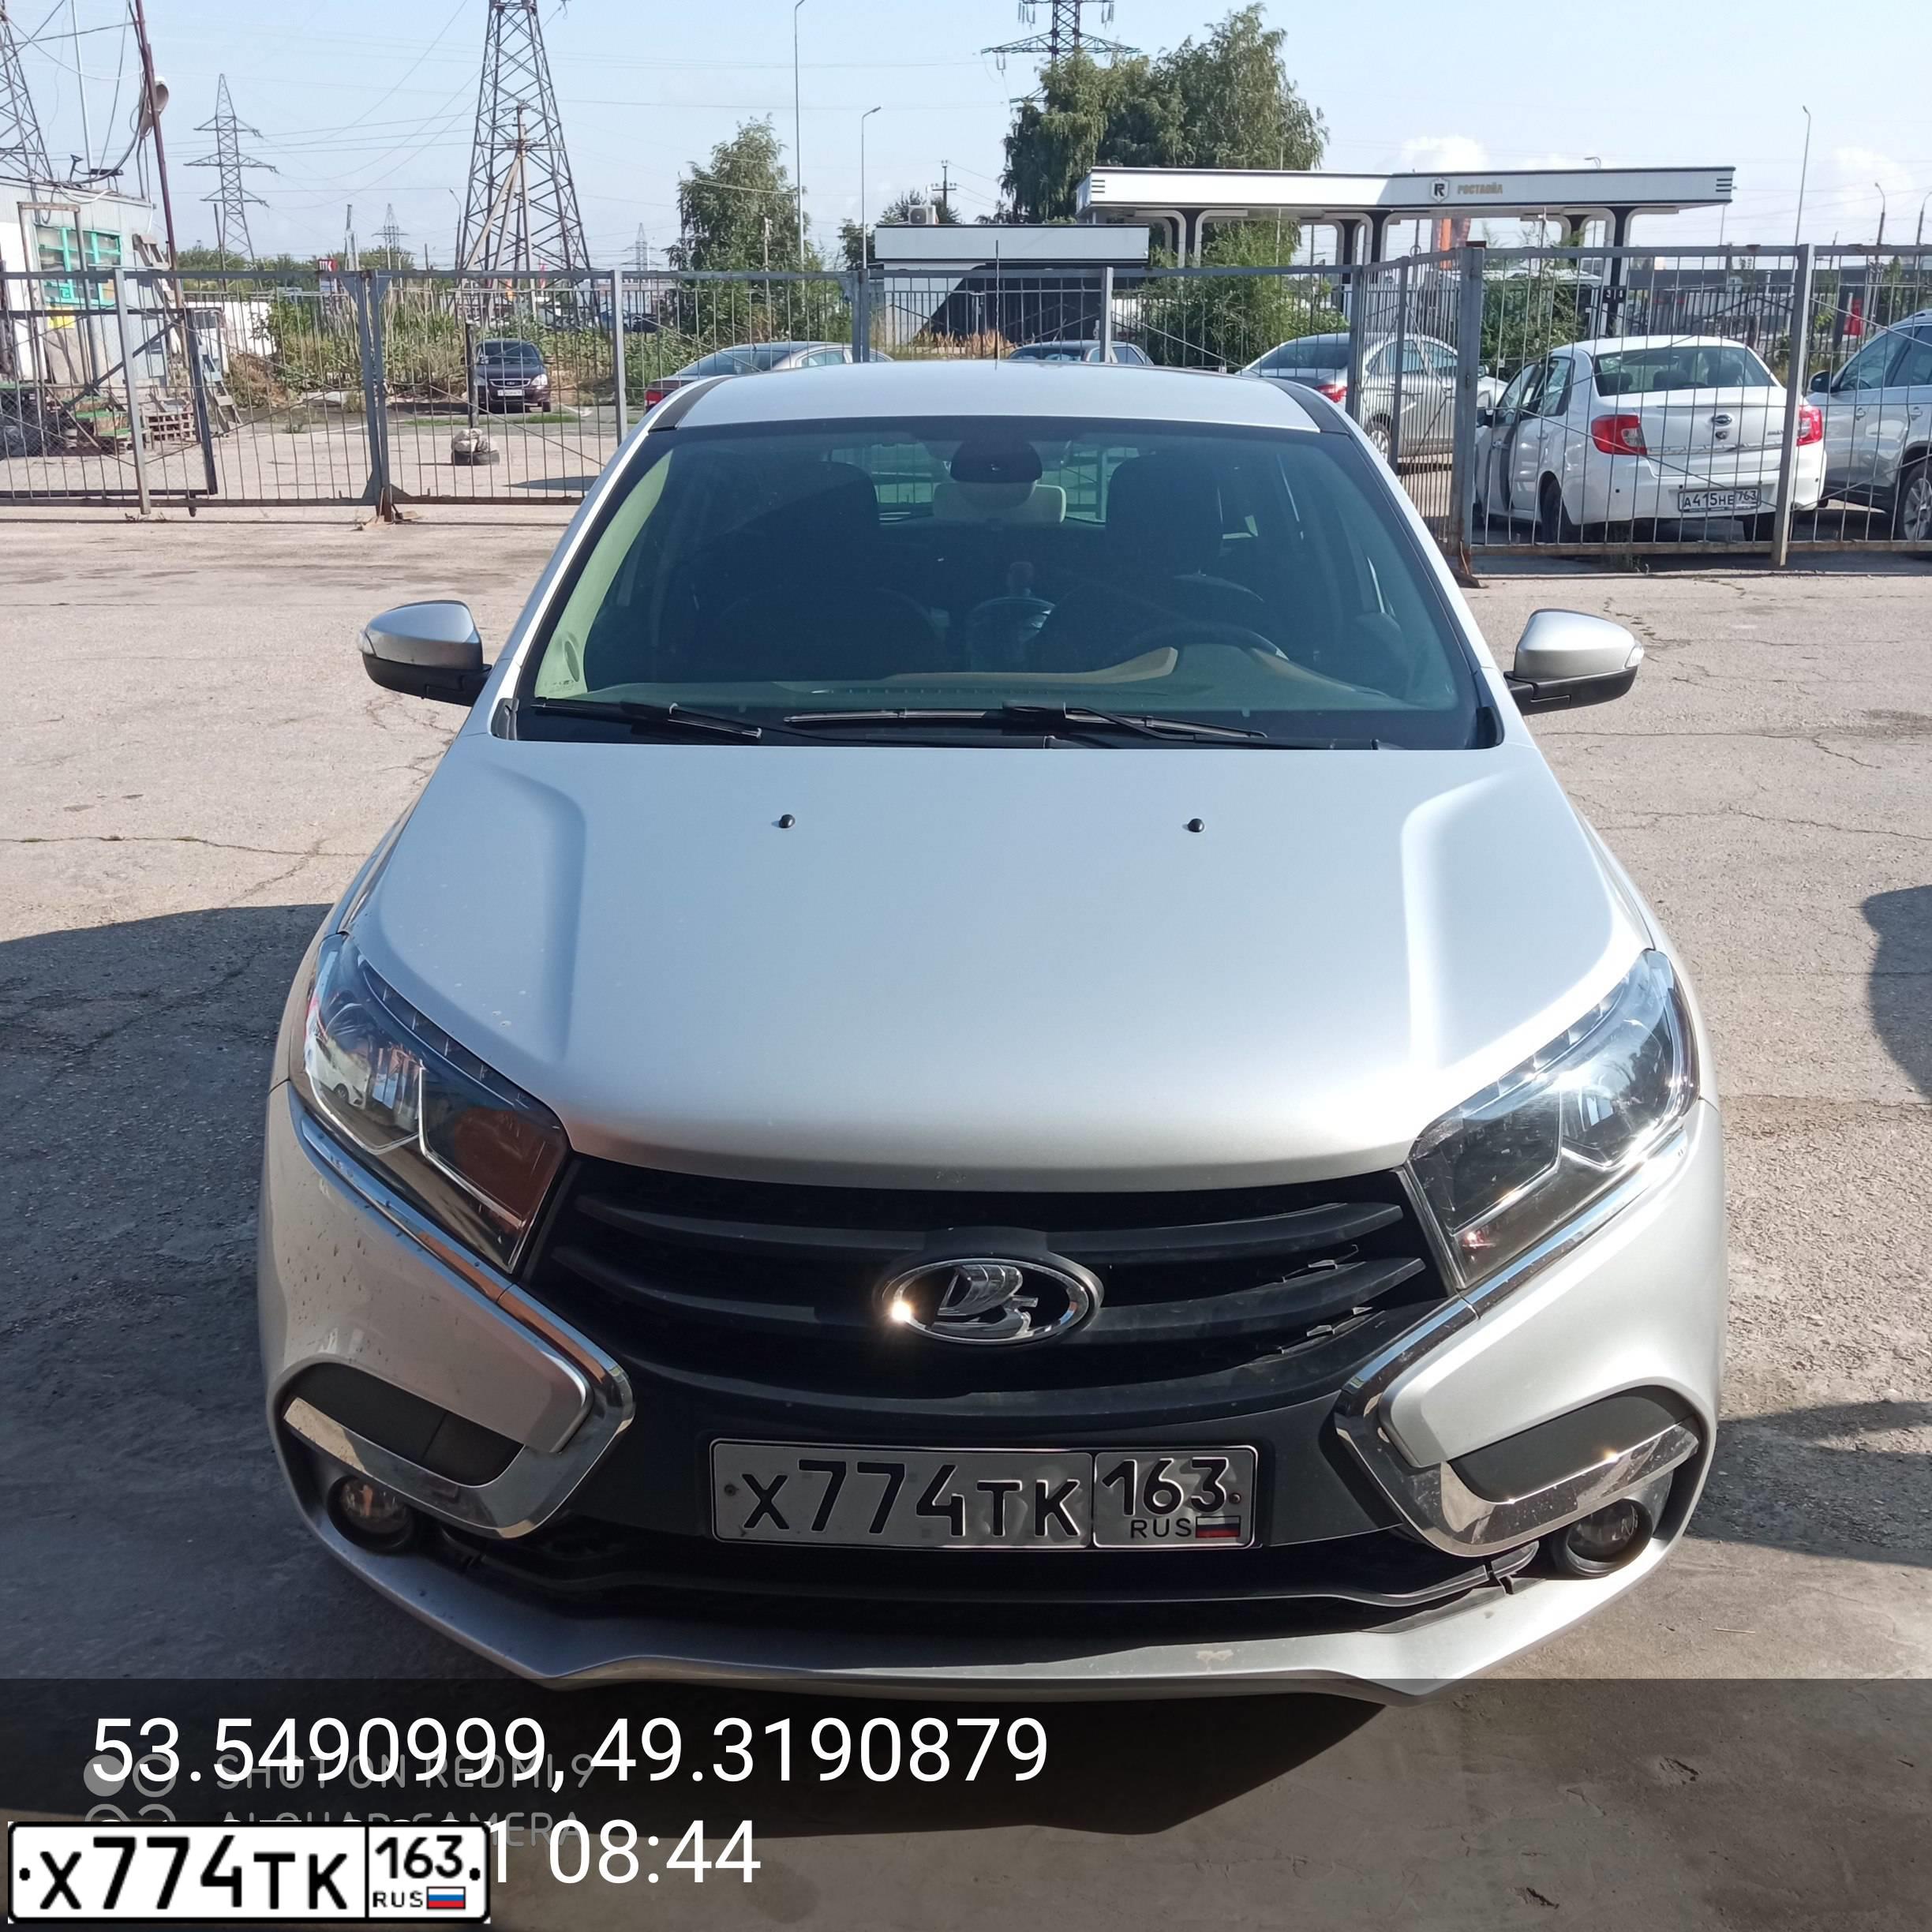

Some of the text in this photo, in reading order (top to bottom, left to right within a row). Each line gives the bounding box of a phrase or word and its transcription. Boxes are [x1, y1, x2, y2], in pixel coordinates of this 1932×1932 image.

[1434, 183, 1445, 197] R
[1101, 1457, 1229, 1516] 163
[1130, 1517, 1191, 1539] RUS
